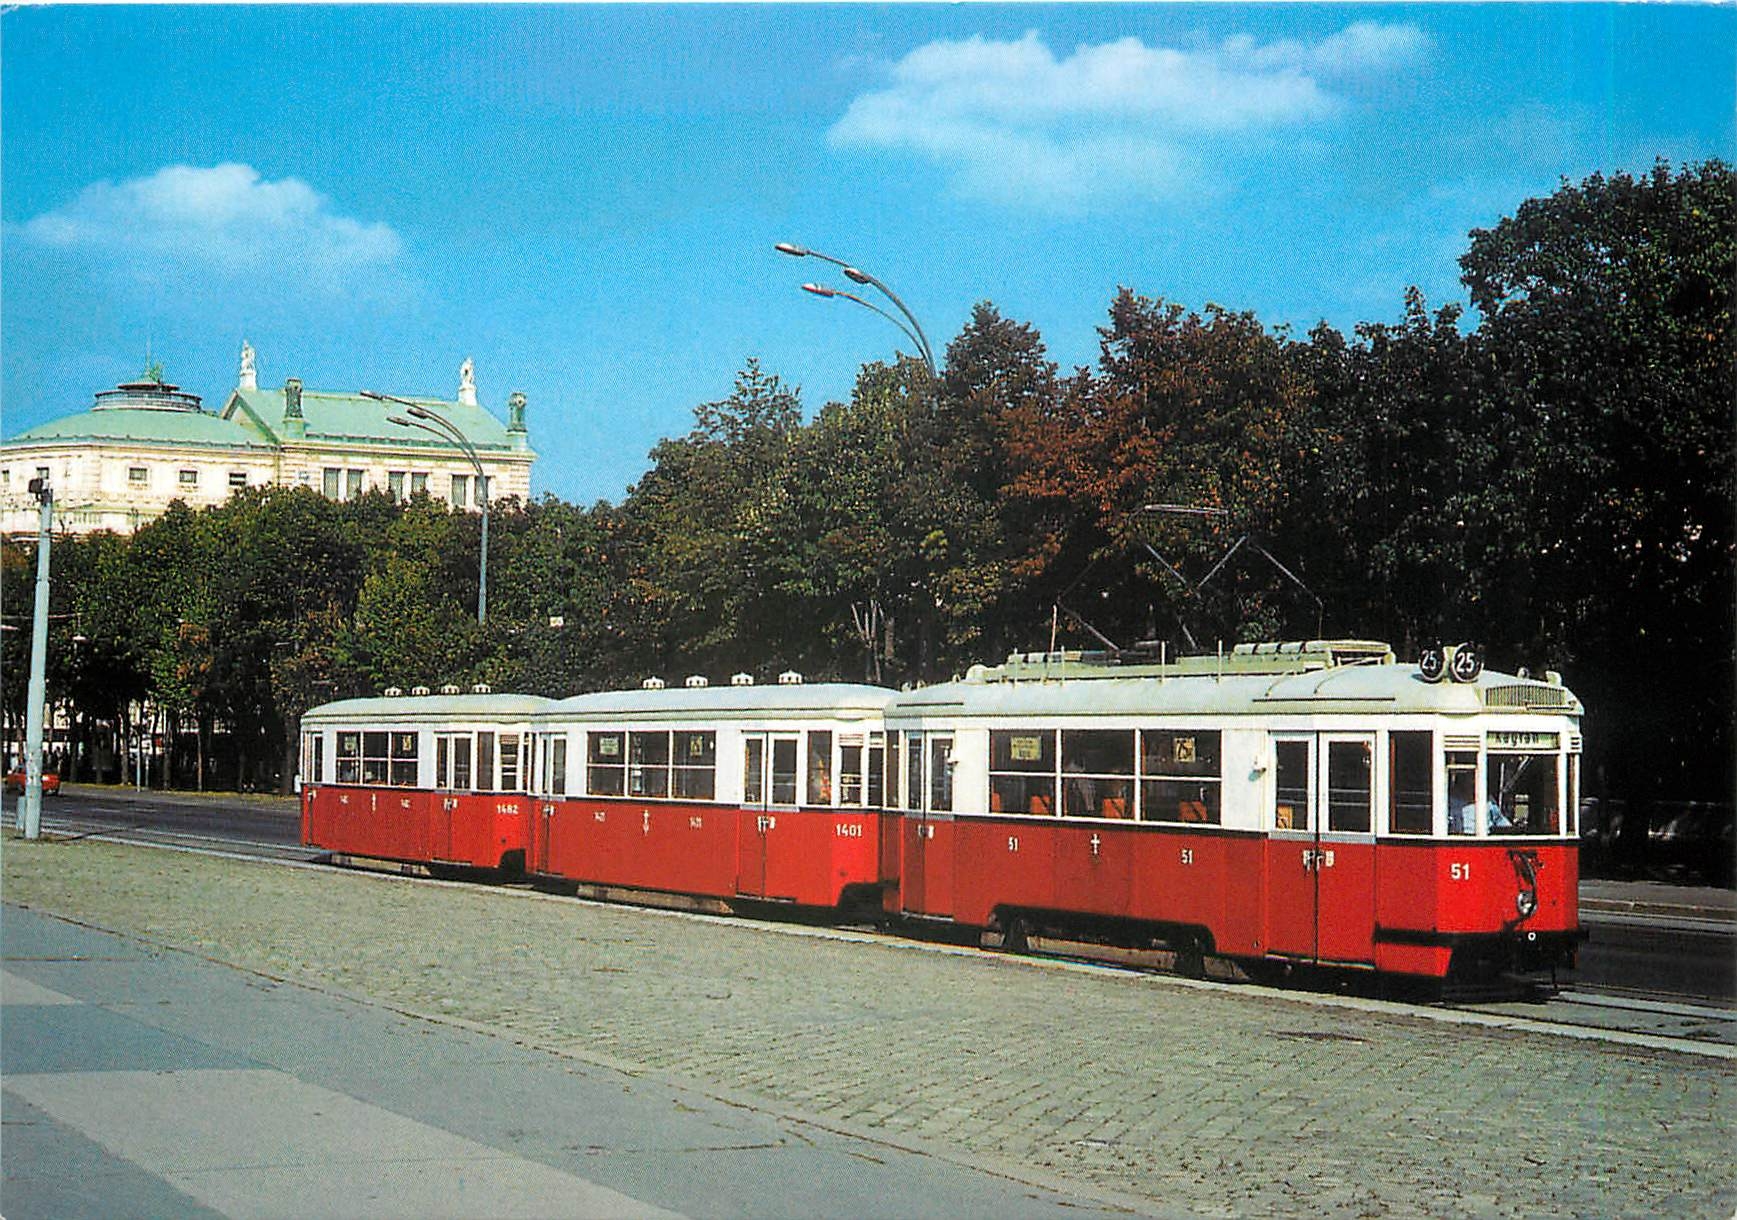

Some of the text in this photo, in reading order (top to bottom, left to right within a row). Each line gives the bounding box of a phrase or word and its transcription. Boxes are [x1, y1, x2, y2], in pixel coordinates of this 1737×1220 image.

[1422, 650, 1437, 670] 25
[1457, 652, 1475, 673] 25
[836, 823, 862, 837] 1401
[1008, 836, 1019, 851] 51
[1181, 849, 1193, 864] 51
[1451, 863, 1470, 880] 51
